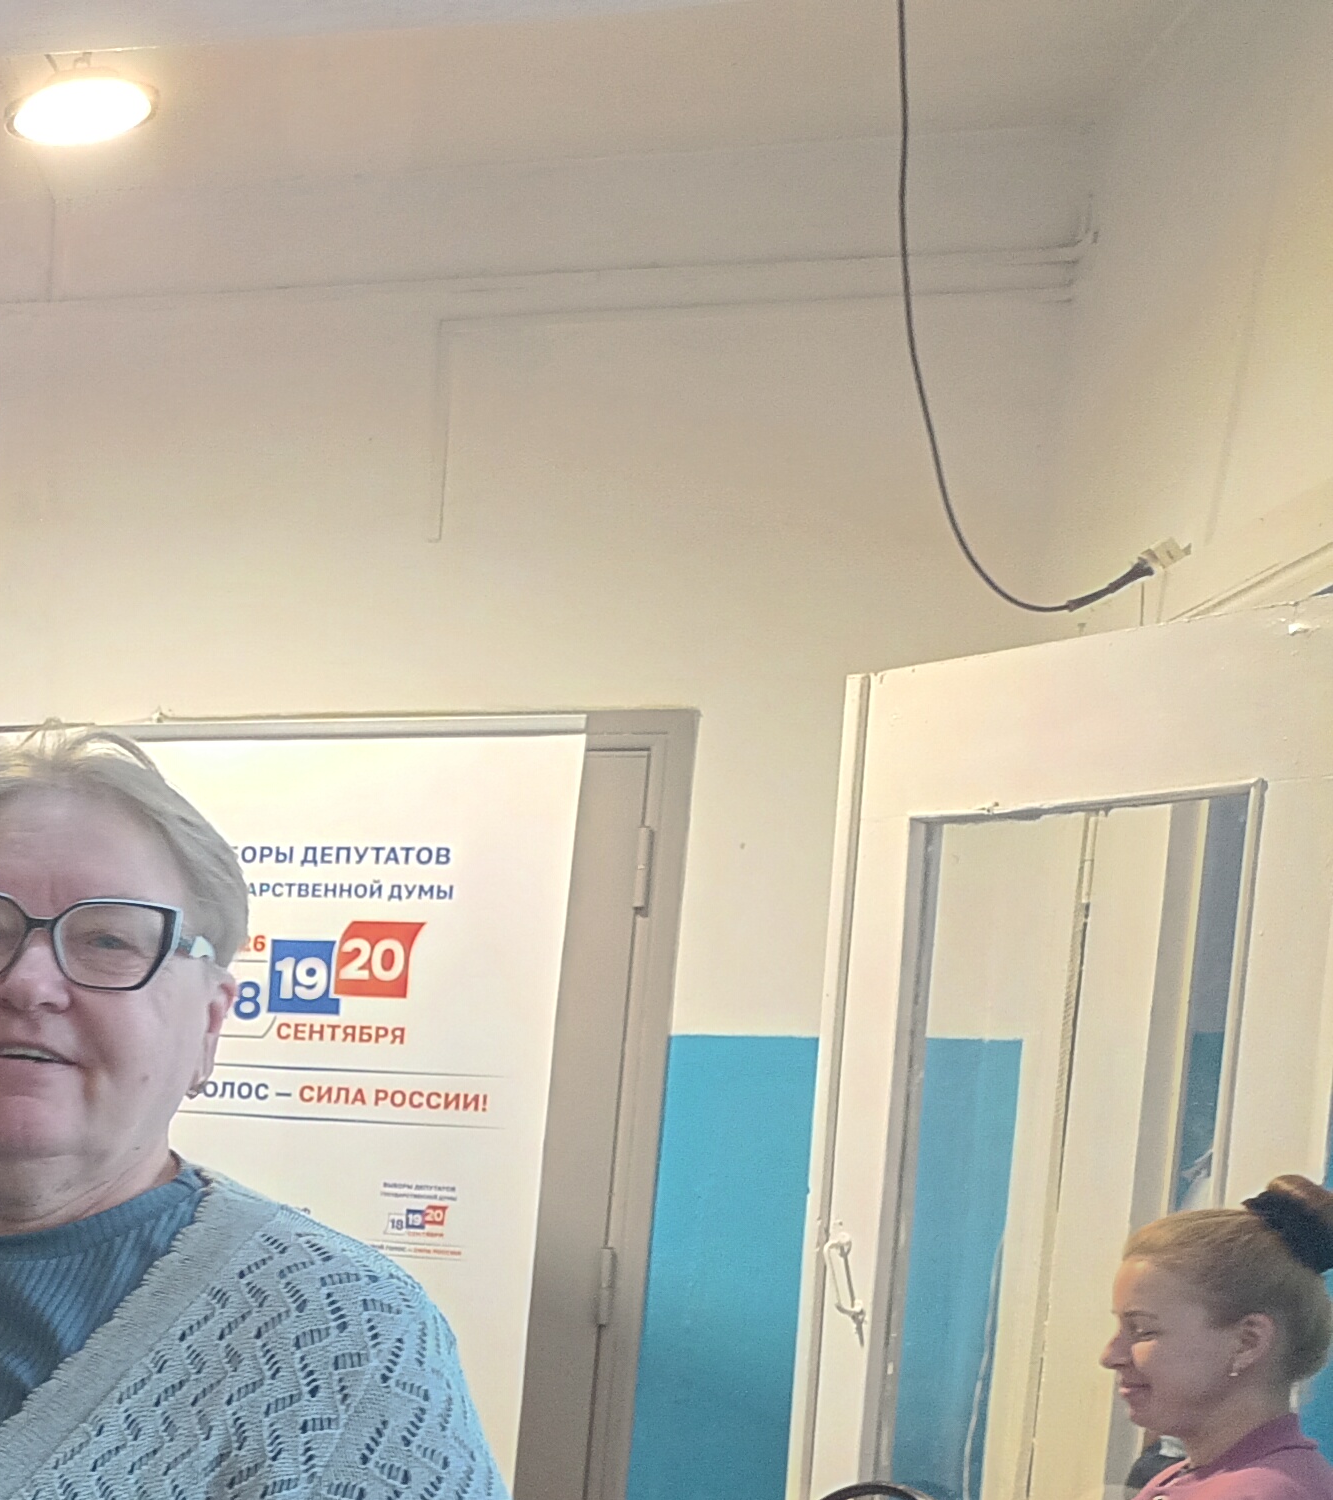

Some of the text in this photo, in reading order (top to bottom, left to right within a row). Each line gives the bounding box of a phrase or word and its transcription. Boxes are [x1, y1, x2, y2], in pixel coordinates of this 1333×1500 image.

[232, 845, 452, 868] ОРЫ ДЕПУТАТОВ
[248, 880, 455, 902] АРСТВЕННОЙ ДУМЫ
[234, 937, 406, 1020] 8 19 20
[275, 1022, 407, 1046] СЕНТЯБРЯ
[202, 1080, 270, 1101] ОЛОС
[298, 1085, 367, 1106] СИЛА
[373, 1088, 489, 1113] РОССИИ!
[407, 1213, 423, 1226] 19
[424, 1208, 444, 1222] 20
